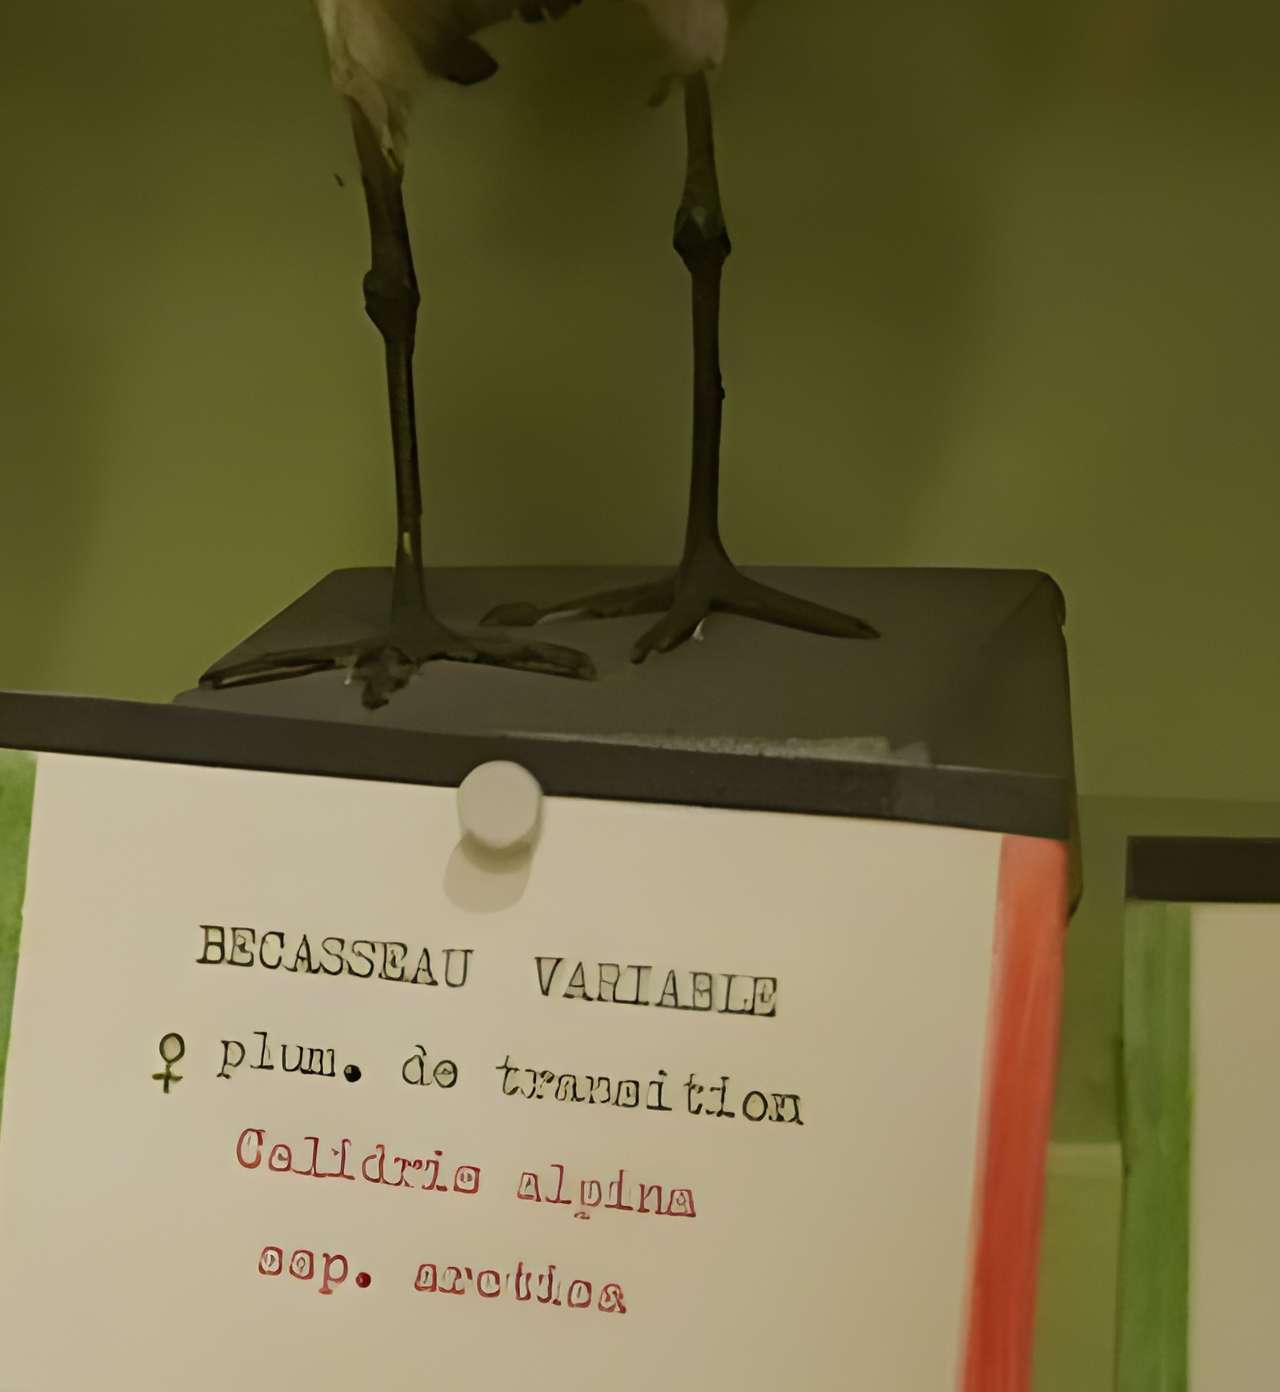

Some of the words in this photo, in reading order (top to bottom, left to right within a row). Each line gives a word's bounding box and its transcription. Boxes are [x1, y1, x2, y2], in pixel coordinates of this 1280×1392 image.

[195, 925, 475, 989] BECASSEAU
[534, 956, 779, 1018] VARIABLE
[217, 1031, 363, 1083] plum.
